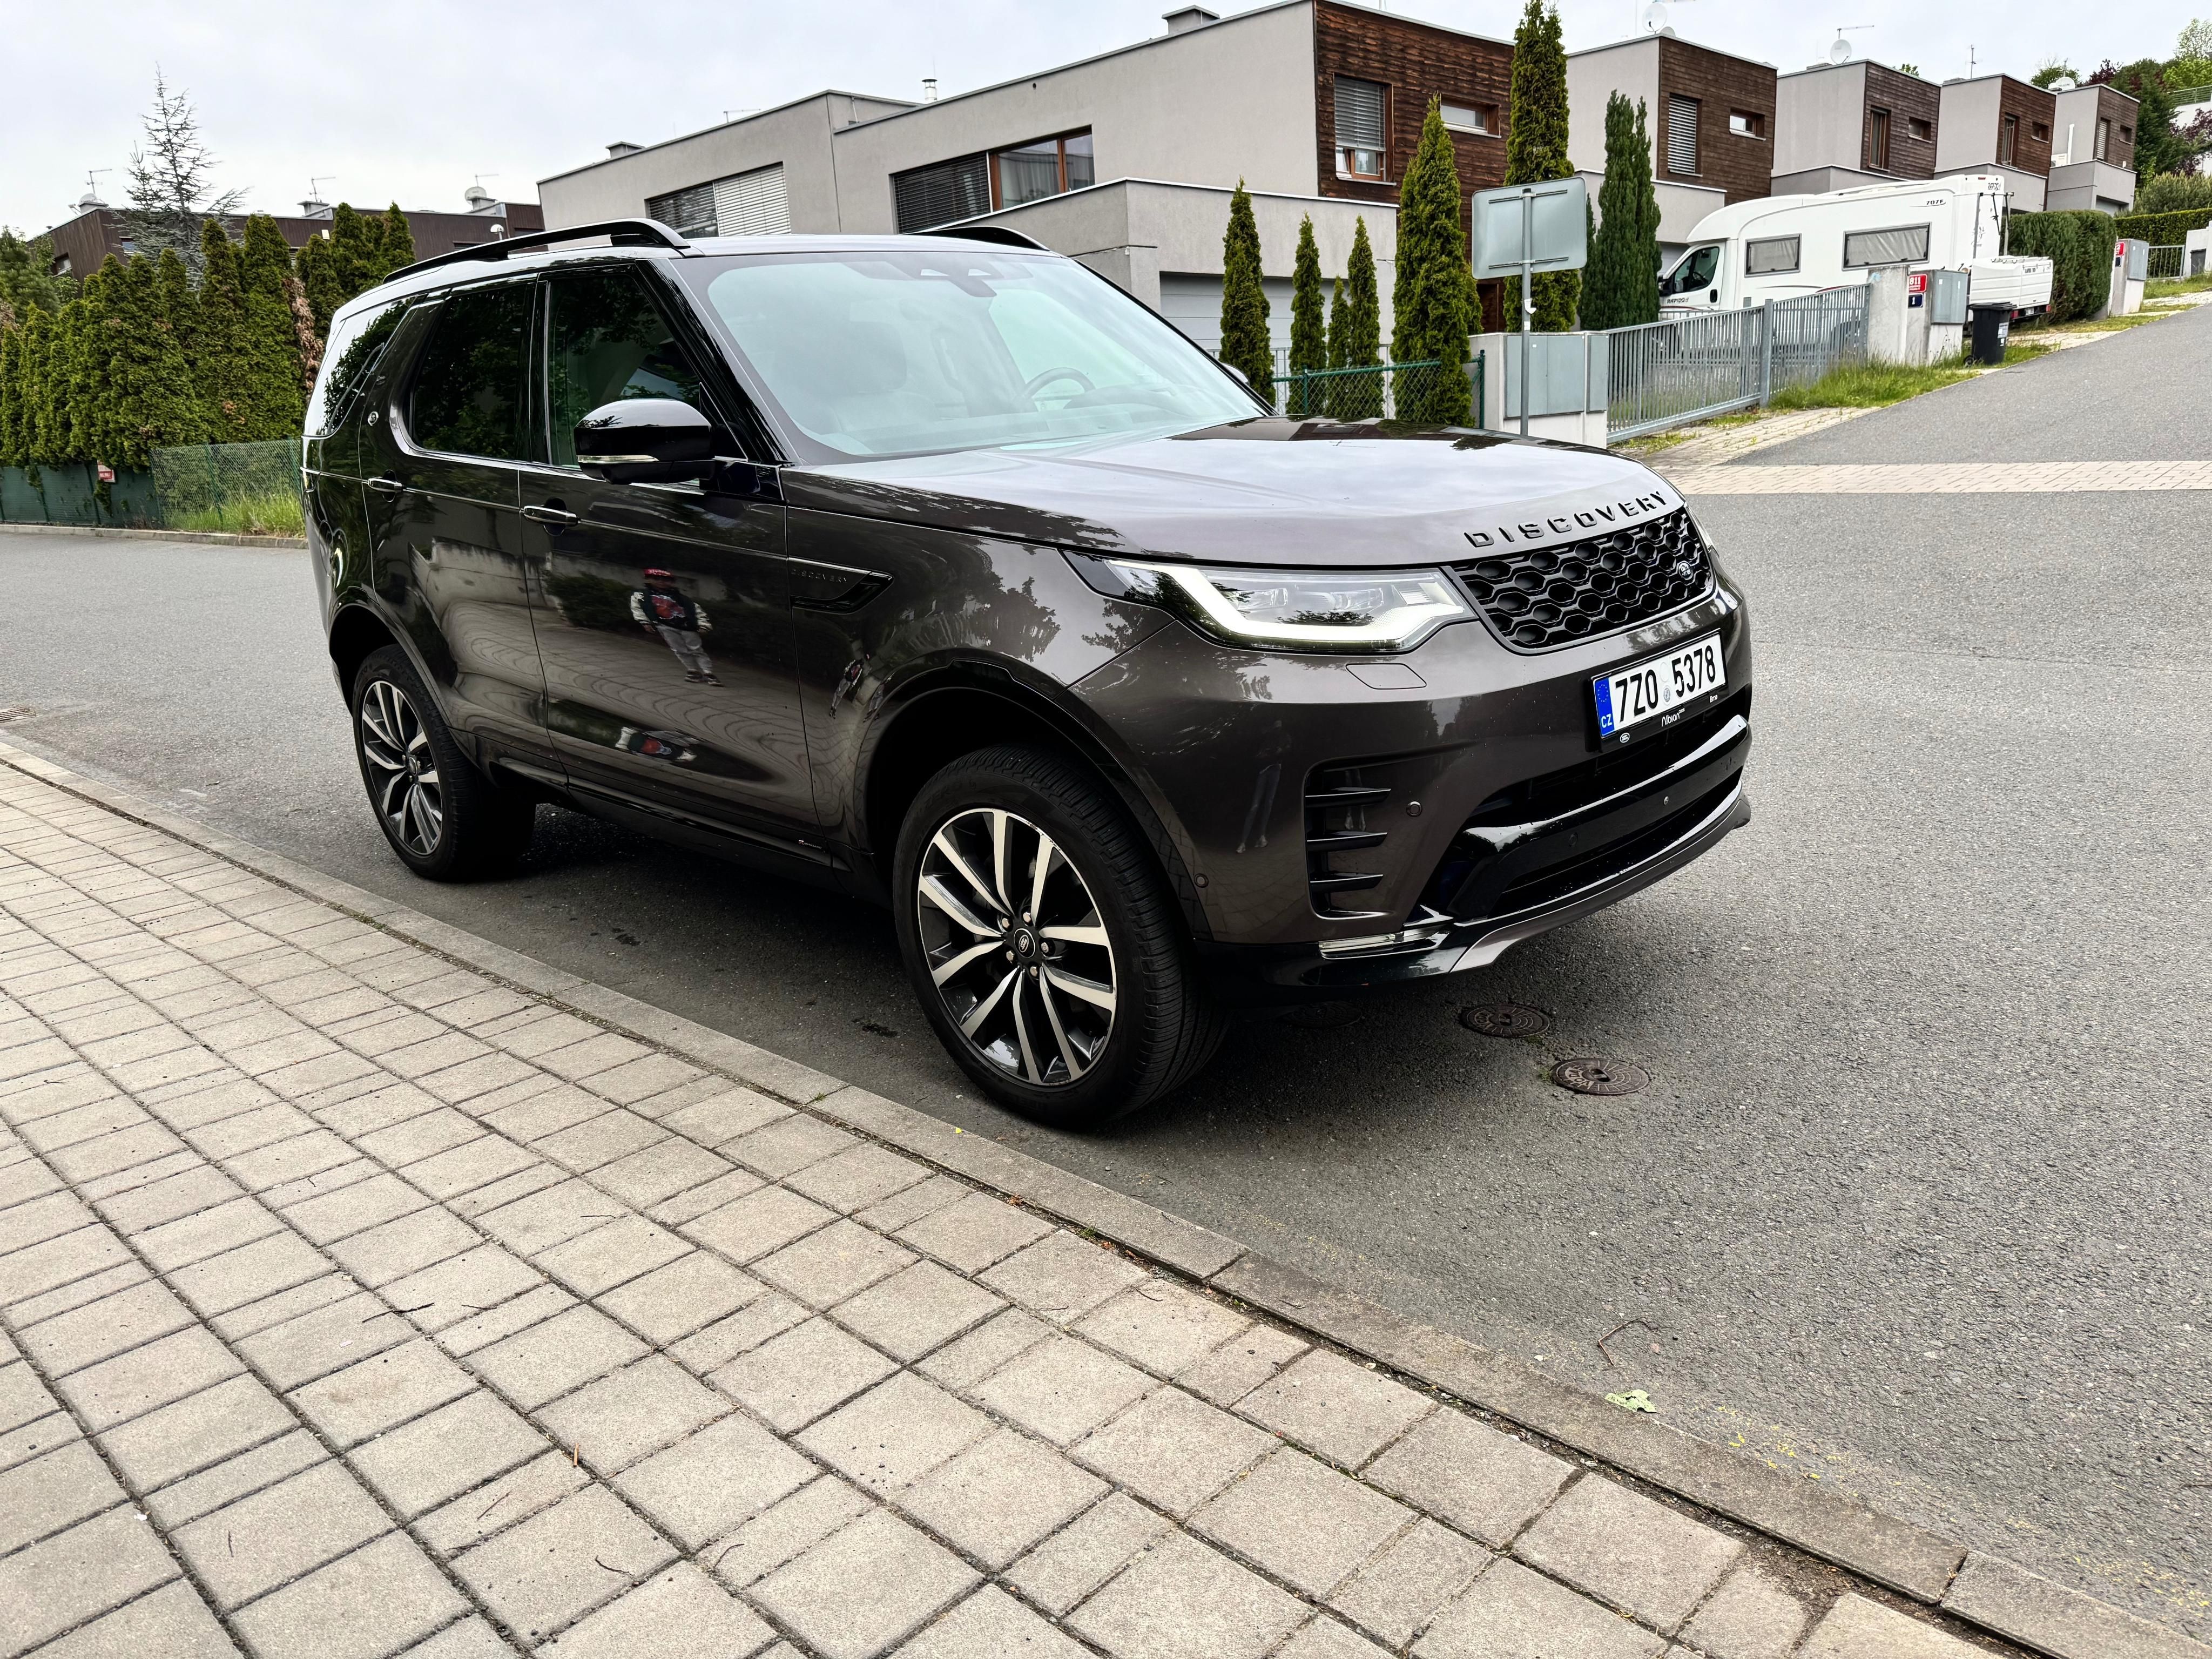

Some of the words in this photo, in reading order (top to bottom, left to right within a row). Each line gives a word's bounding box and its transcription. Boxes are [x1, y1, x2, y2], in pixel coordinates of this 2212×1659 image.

[1910, 276, 1921, 285] 811
[1912, 296, 1916, 305] 1
[1464, 491, 1667, 548] DISCOVERY
[1671, 645, 1716, 697] 5378
[1601, 713, 1612, 728] CZ
[1662, 713, 1680, 727] Albion
